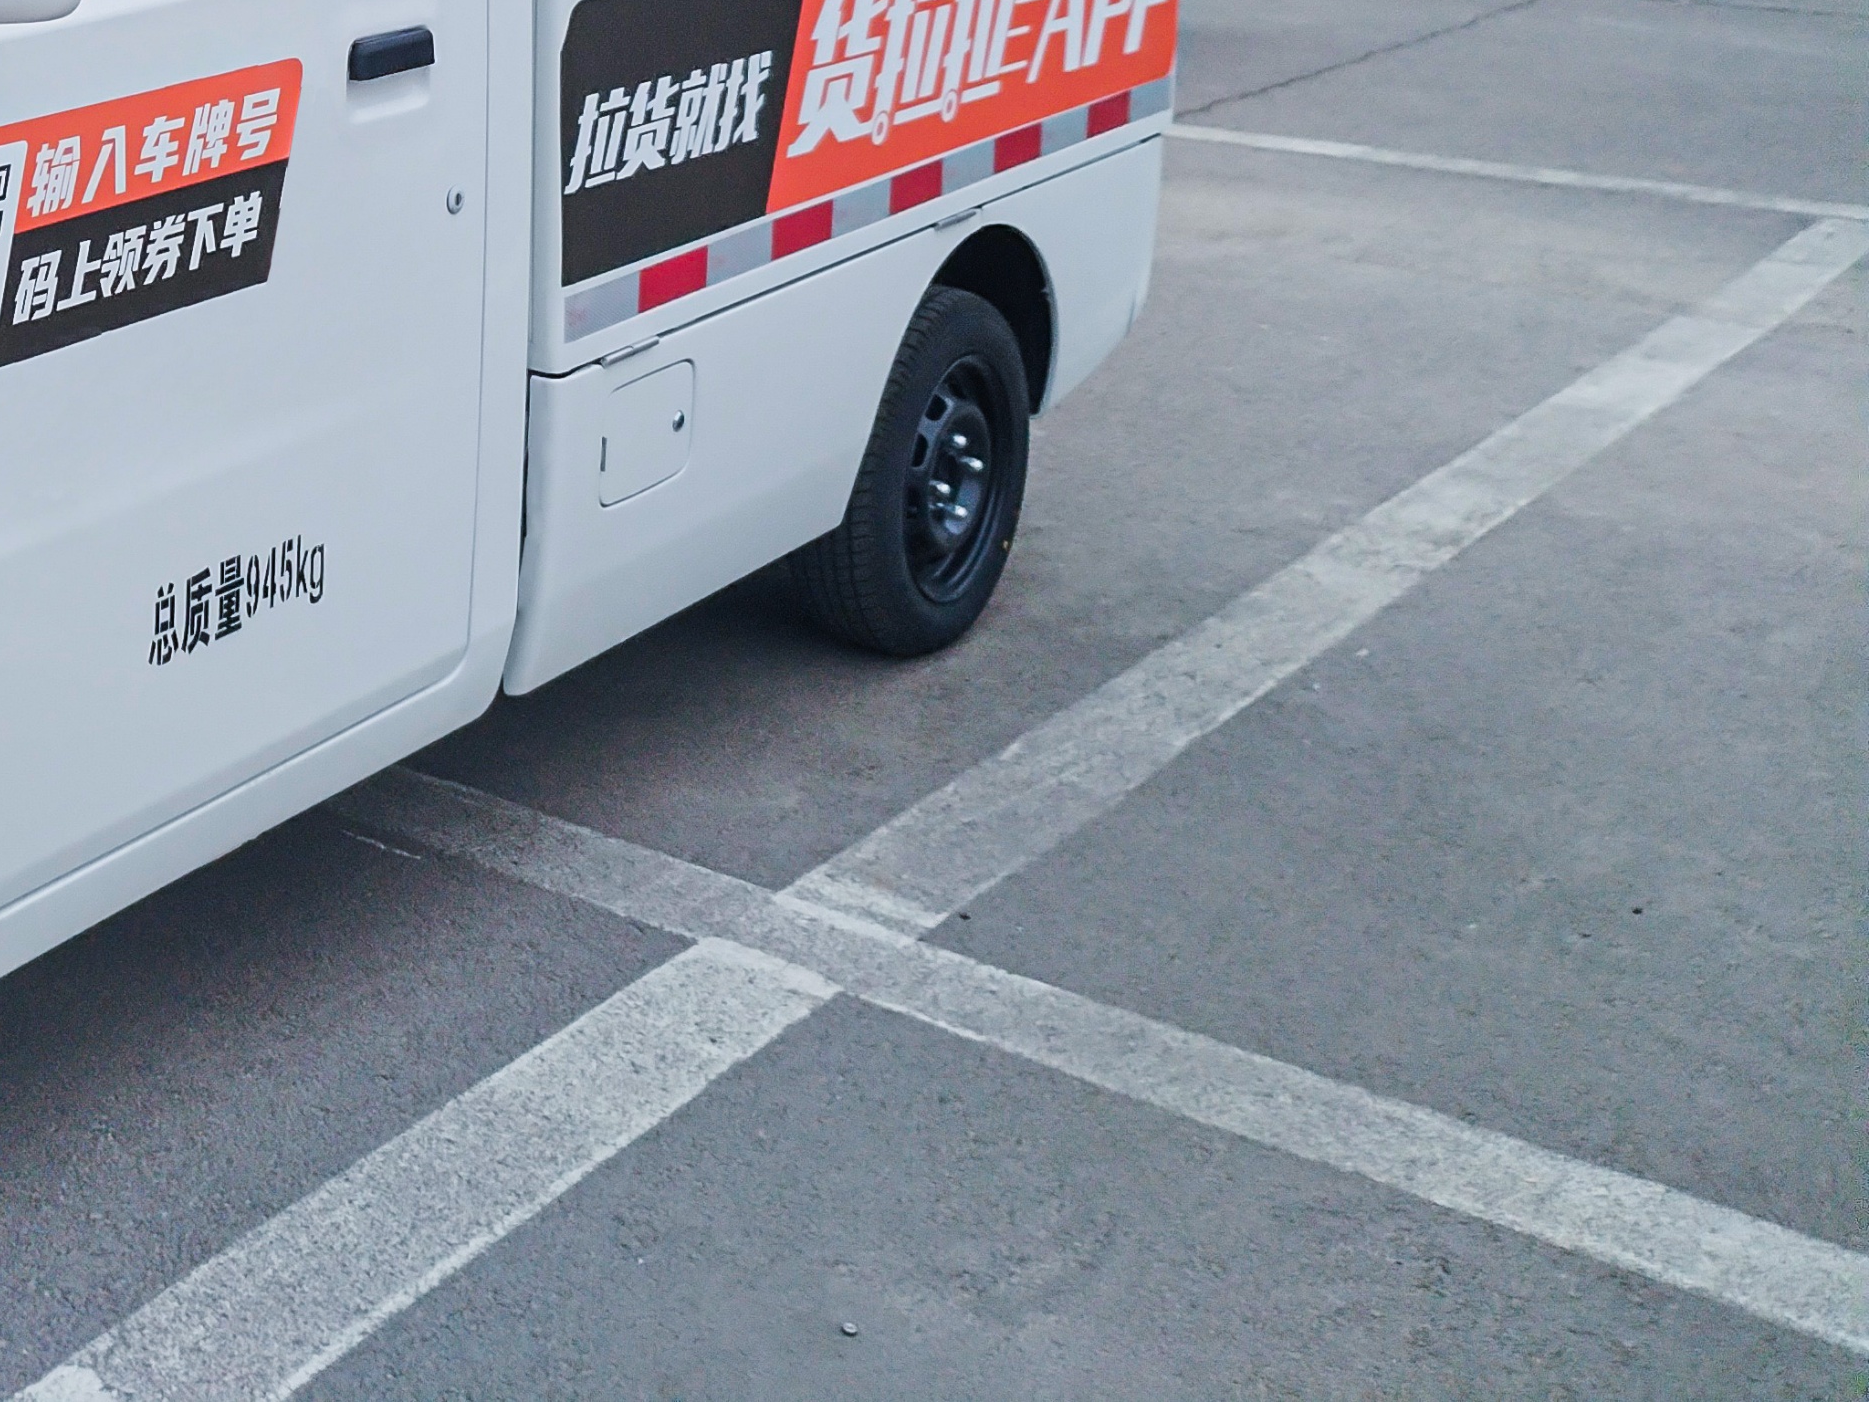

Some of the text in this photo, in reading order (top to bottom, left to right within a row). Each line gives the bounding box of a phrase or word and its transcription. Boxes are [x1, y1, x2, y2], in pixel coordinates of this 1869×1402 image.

[26, 88, 282, 218] 输入车牌号
[564, 50, 773, 195] 拉货就找
[13, 190, 263, 326] 码上领券下单
[148, 534, 325, 666] 总质量945kg
